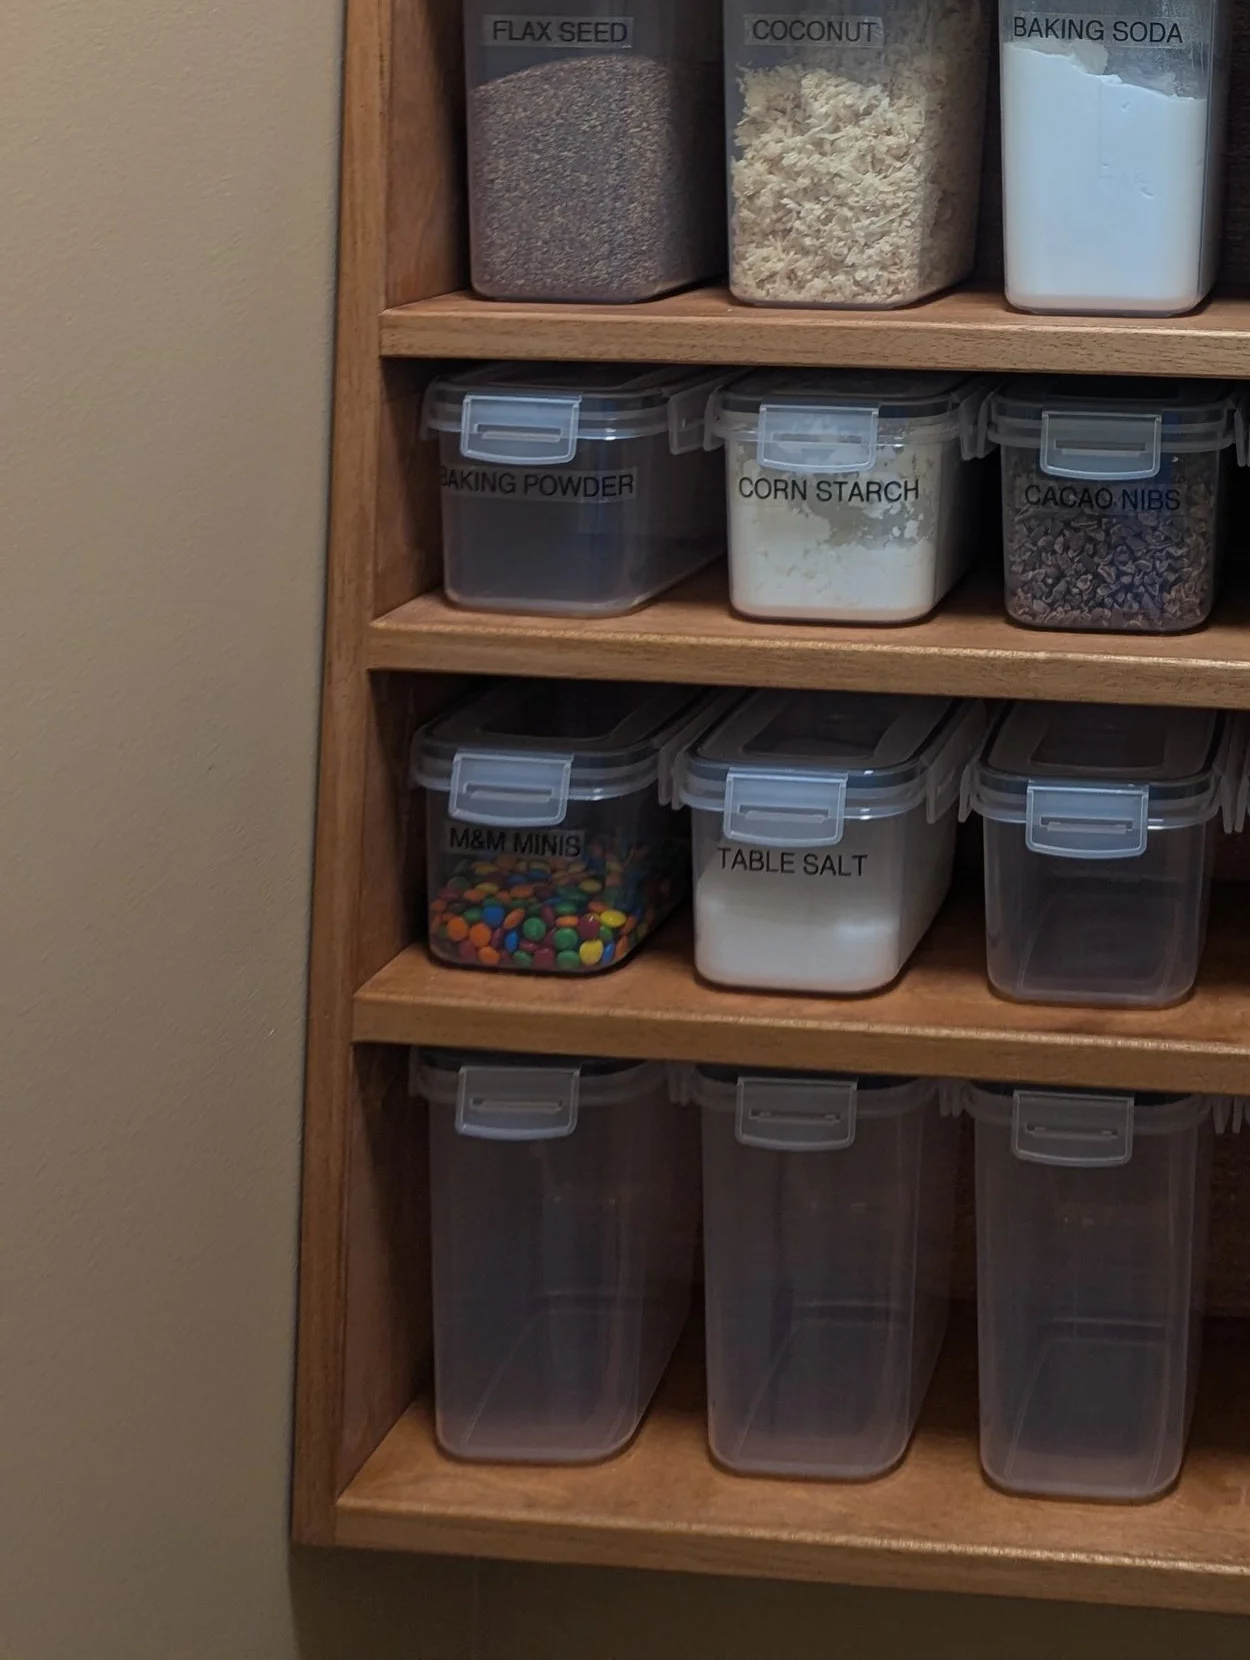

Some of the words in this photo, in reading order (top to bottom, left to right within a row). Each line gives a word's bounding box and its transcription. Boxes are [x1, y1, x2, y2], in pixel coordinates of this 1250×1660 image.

[493, 20, 552, 42] FLAX
[559, 20, 628, 42] SEED
[752, 19, 877, 42] COCONUT
[1013, 16, 1105, 42] BAKING
[1112, 19, 1184, 43] SODA
[523, 473, 635, 500] POWDER
[738, 476, 811, 502] CORN
[816, 478, 921, 503] STARCH
[1025, 484, 1114, 510] CACAO
[1121, 486, 1181, 511] NIBS
[449, 827, 509, 853] M&M
[513, 830, 582, 857] MINIS
[717, 847, 795, 875] TABLE
[802, 853, 868, 877] SALT
